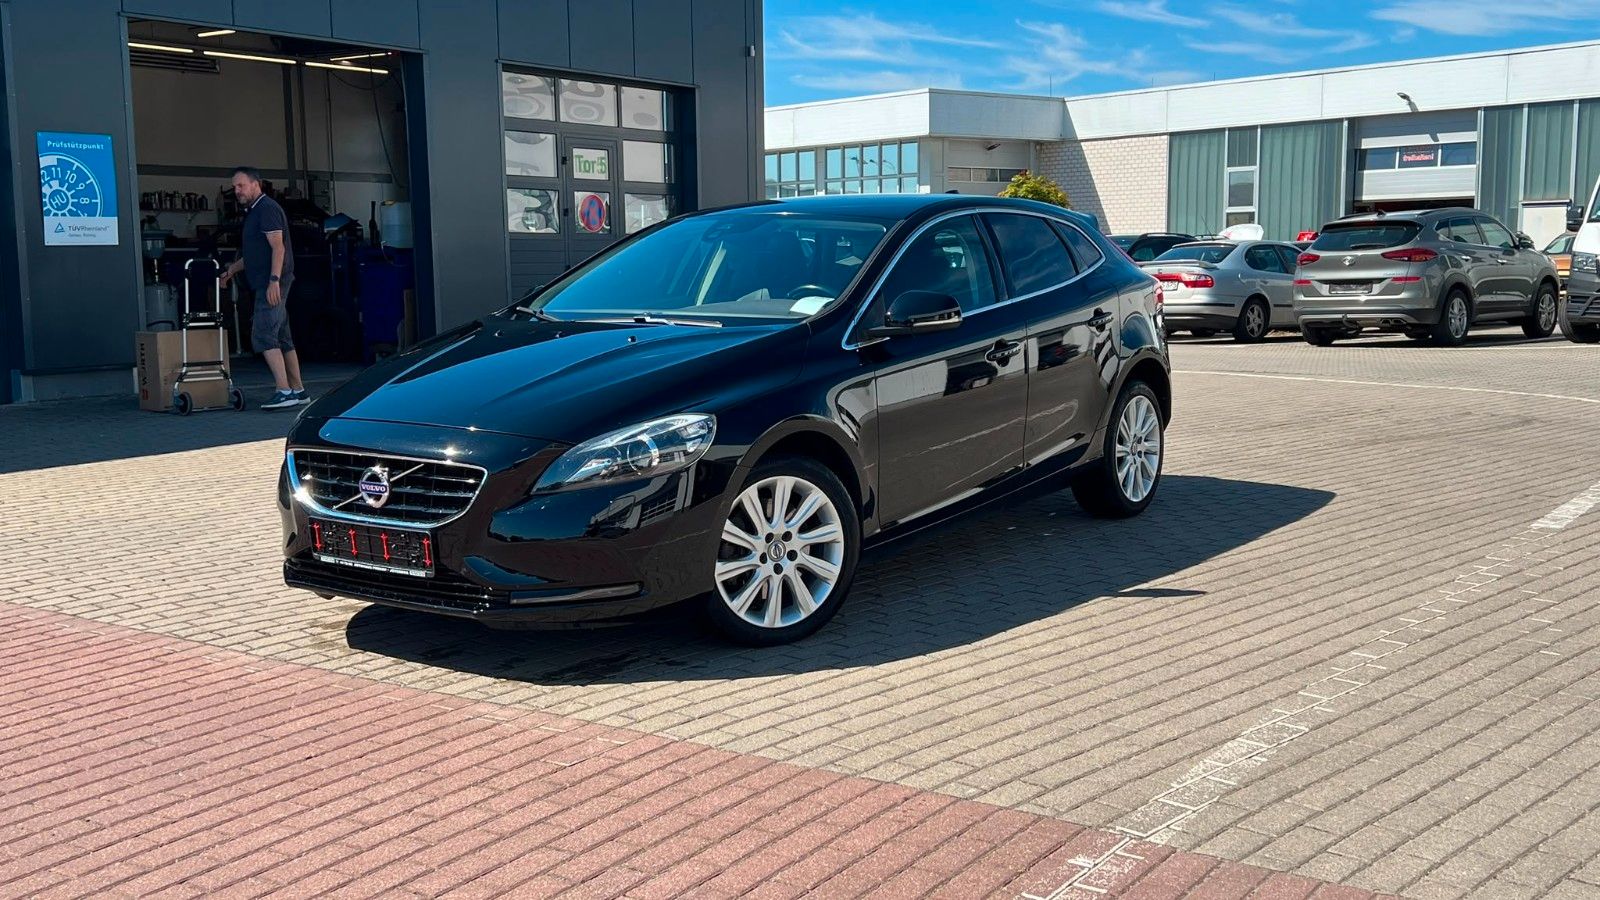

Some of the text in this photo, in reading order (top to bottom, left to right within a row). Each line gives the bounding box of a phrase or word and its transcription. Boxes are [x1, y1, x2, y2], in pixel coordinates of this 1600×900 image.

[47, 140, 104, 150] Prüfstützpunkt
[575, 155, 597, 173] Tor
[65, 170, 77, 184] 10
[76, 182, 86, 190] 9
[50, 192, 67, 209] HU
[361, 484, 386, 492] VOLVO
